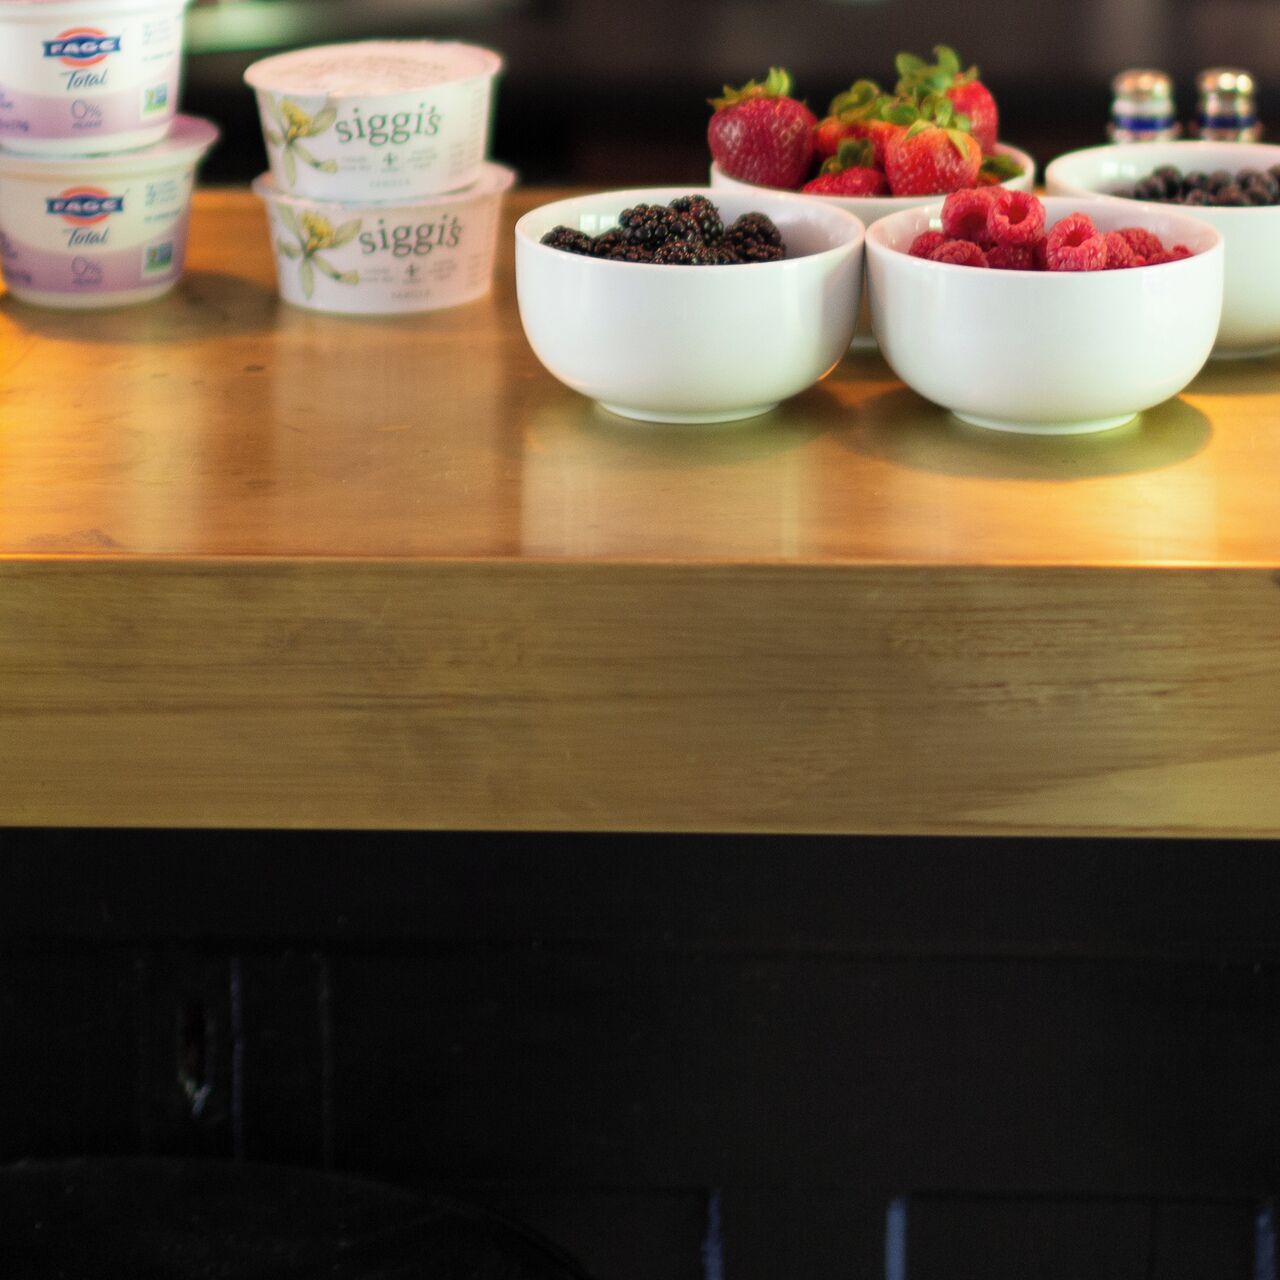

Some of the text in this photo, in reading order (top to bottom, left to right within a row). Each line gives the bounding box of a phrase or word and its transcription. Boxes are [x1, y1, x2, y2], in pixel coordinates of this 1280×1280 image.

[59, 69, 107, 91] Total
[335, 102, 444, 147] siggi's
[62, 226, 110, 248] Total
[358, 214, 463, 257] siggi's
